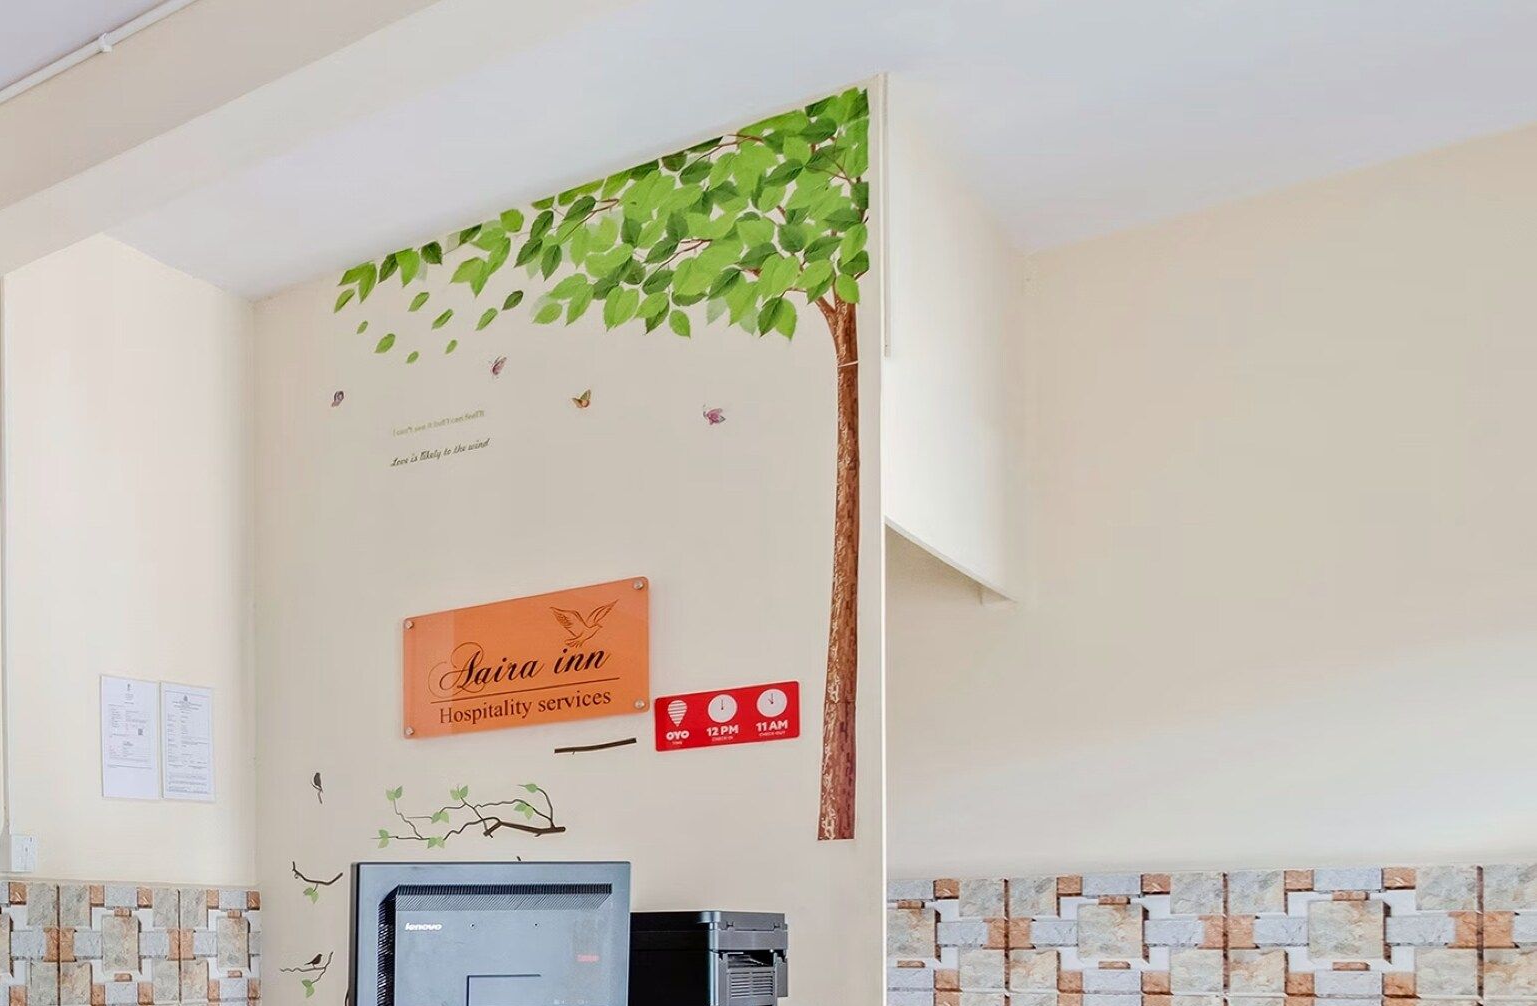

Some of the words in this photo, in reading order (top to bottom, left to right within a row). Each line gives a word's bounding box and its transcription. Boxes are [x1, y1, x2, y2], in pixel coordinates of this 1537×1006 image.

[443, 448, 452, 457] to
[453, 444, 466, 454] the
[468, 438, 490, 451] wind
[428, 641, 546, 697] Aaira
[552, 646, 614, 676] inn
[439, 697, 534, 725] Hospitality
[537, 691, 612, 714] services
[706, 727, 718, 737] 12
[720, 724, 739, 735] PM
[756, 721, 767, 732] 11
[768, 720, 789, 730] AM
[666, 730, 690, 741] OYO
[405, 923, 443, 931] lenovo
